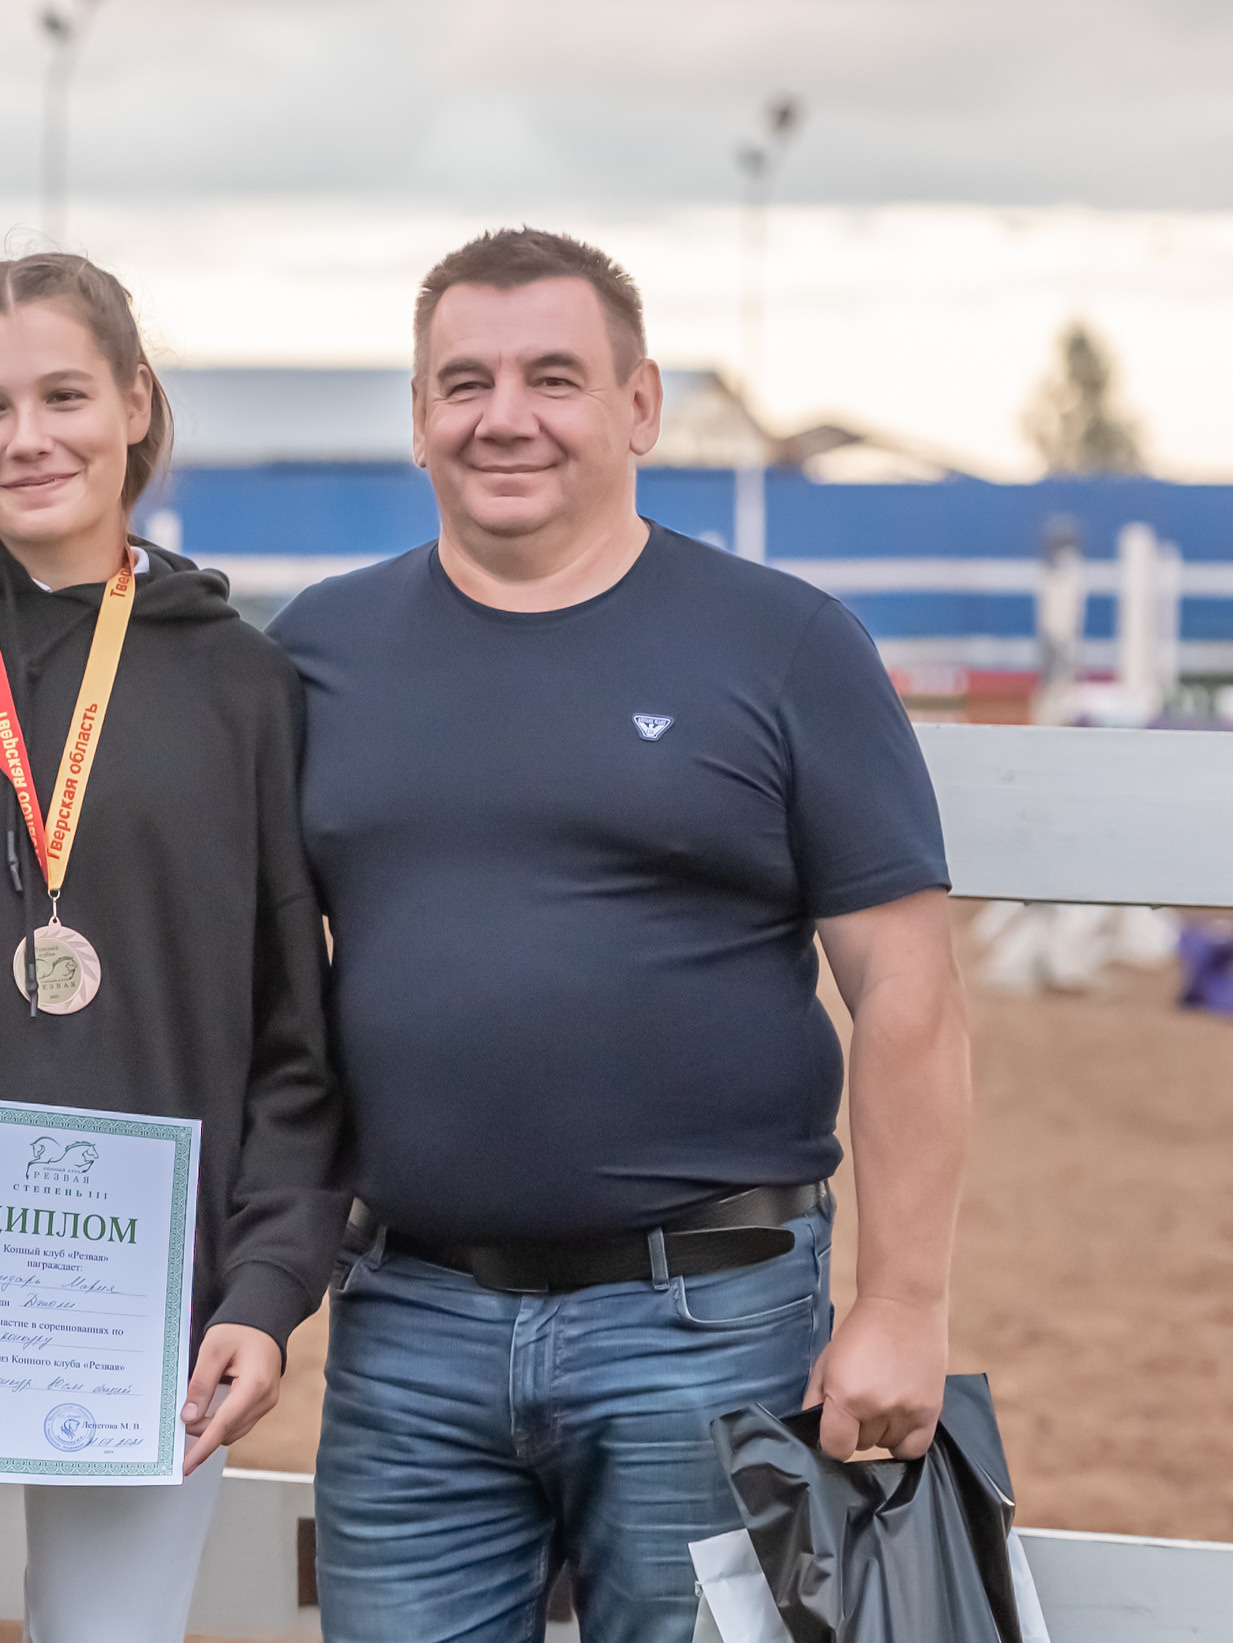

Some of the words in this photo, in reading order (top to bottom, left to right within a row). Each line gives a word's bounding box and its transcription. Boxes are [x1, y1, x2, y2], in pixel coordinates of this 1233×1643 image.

[70, 702, 98, 775] область
[43, 982, 76, 991] ЕЗВАЯ
[34, 1171, 90, 1184] РЕЗВАЯ
[13, 1184, 82, 1197] СТЕПЕНЬ
[3, 1244, 40, 1256] Конный
[43, 1248, 65, 1259] клуб
[67, 1252, 109, 1262] «Резвая»
[27, 1260, 83, 1272] награждает:
[62, 1276, 121, 1294] Мария
[39, 1322, 110, 1335] соревнованиях
[112, 1328, 123, 1336] по
[12, 1355, 51, 1367] Конного
[54, 1359, 81, 1370] клуба
[84, 1361, 125, 1371] «Резвая»
